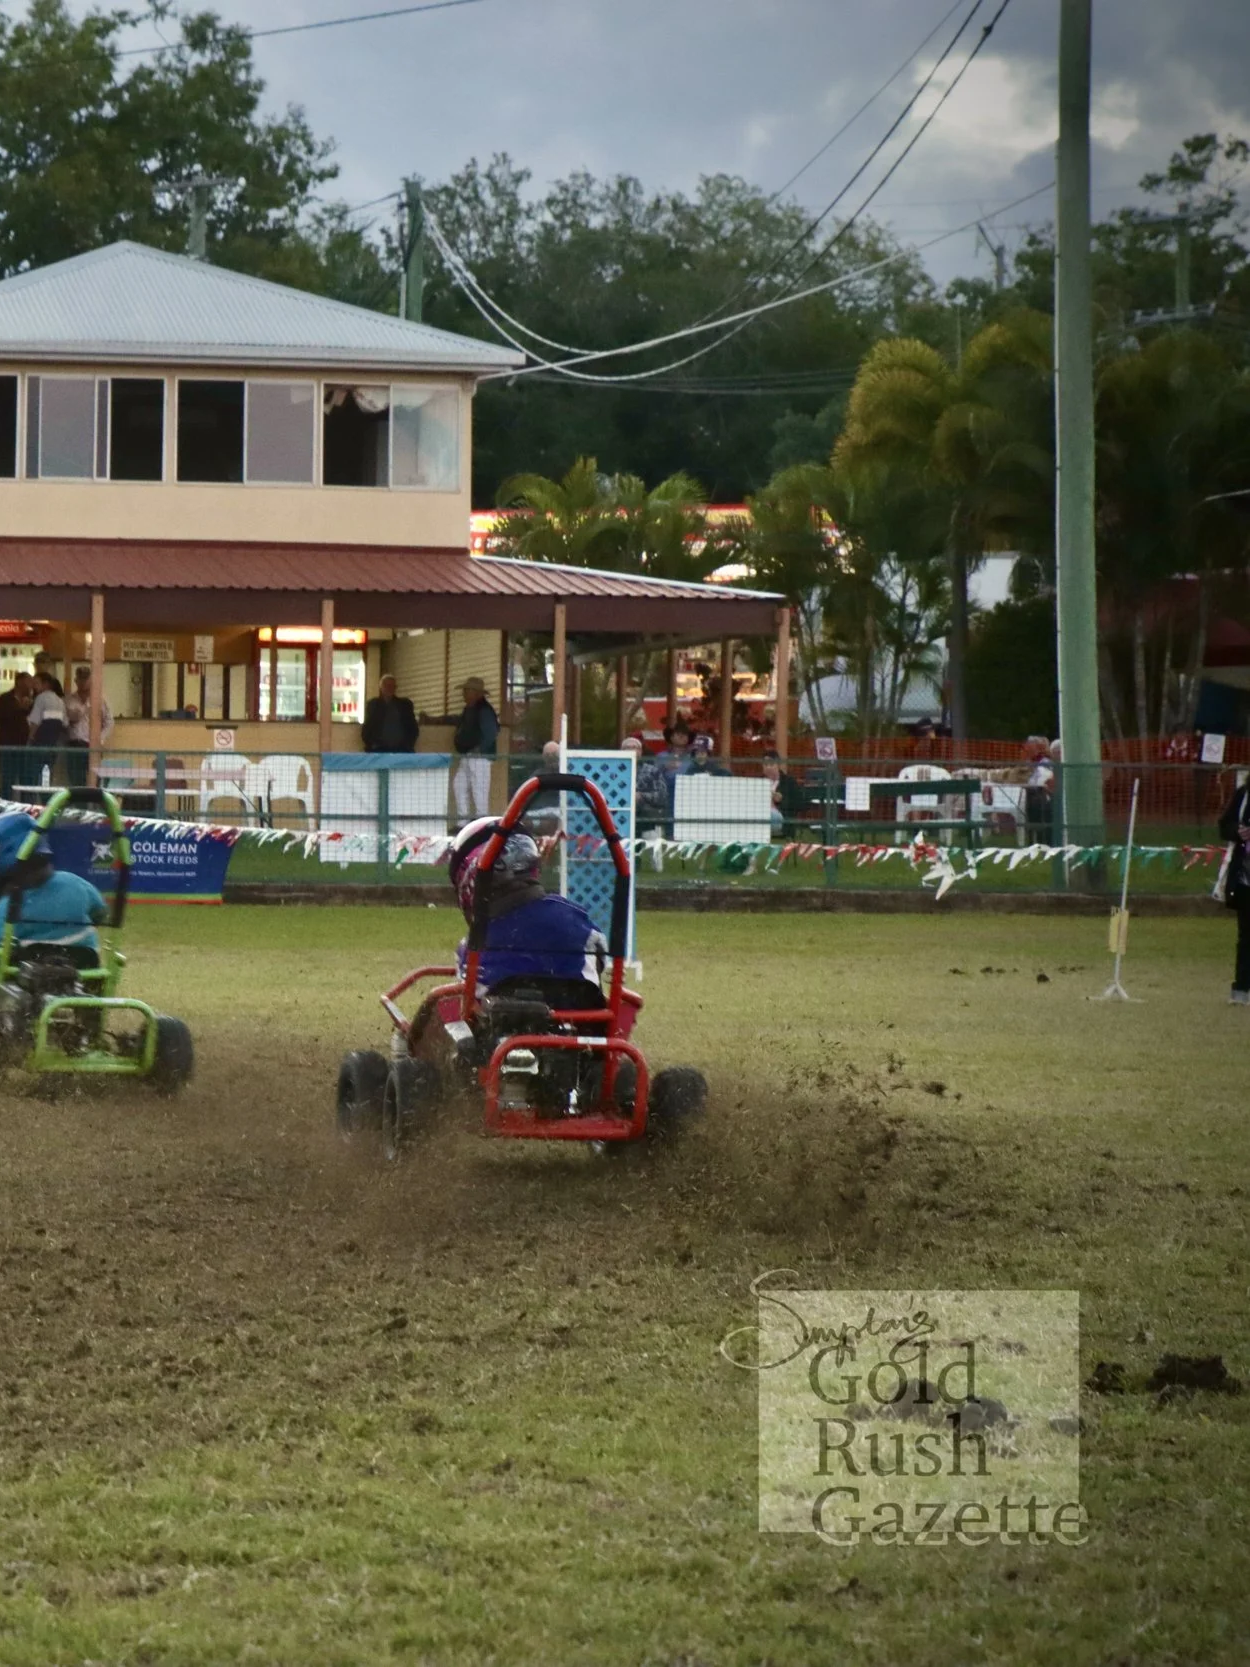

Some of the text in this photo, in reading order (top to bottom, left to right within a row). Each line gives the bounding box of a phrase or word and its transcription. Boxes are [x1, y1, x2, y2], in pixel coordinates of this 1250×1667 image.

[132, 841, 198, 854] COLEMAN
[130, 854, 199, 865] STOCK FEEDS
